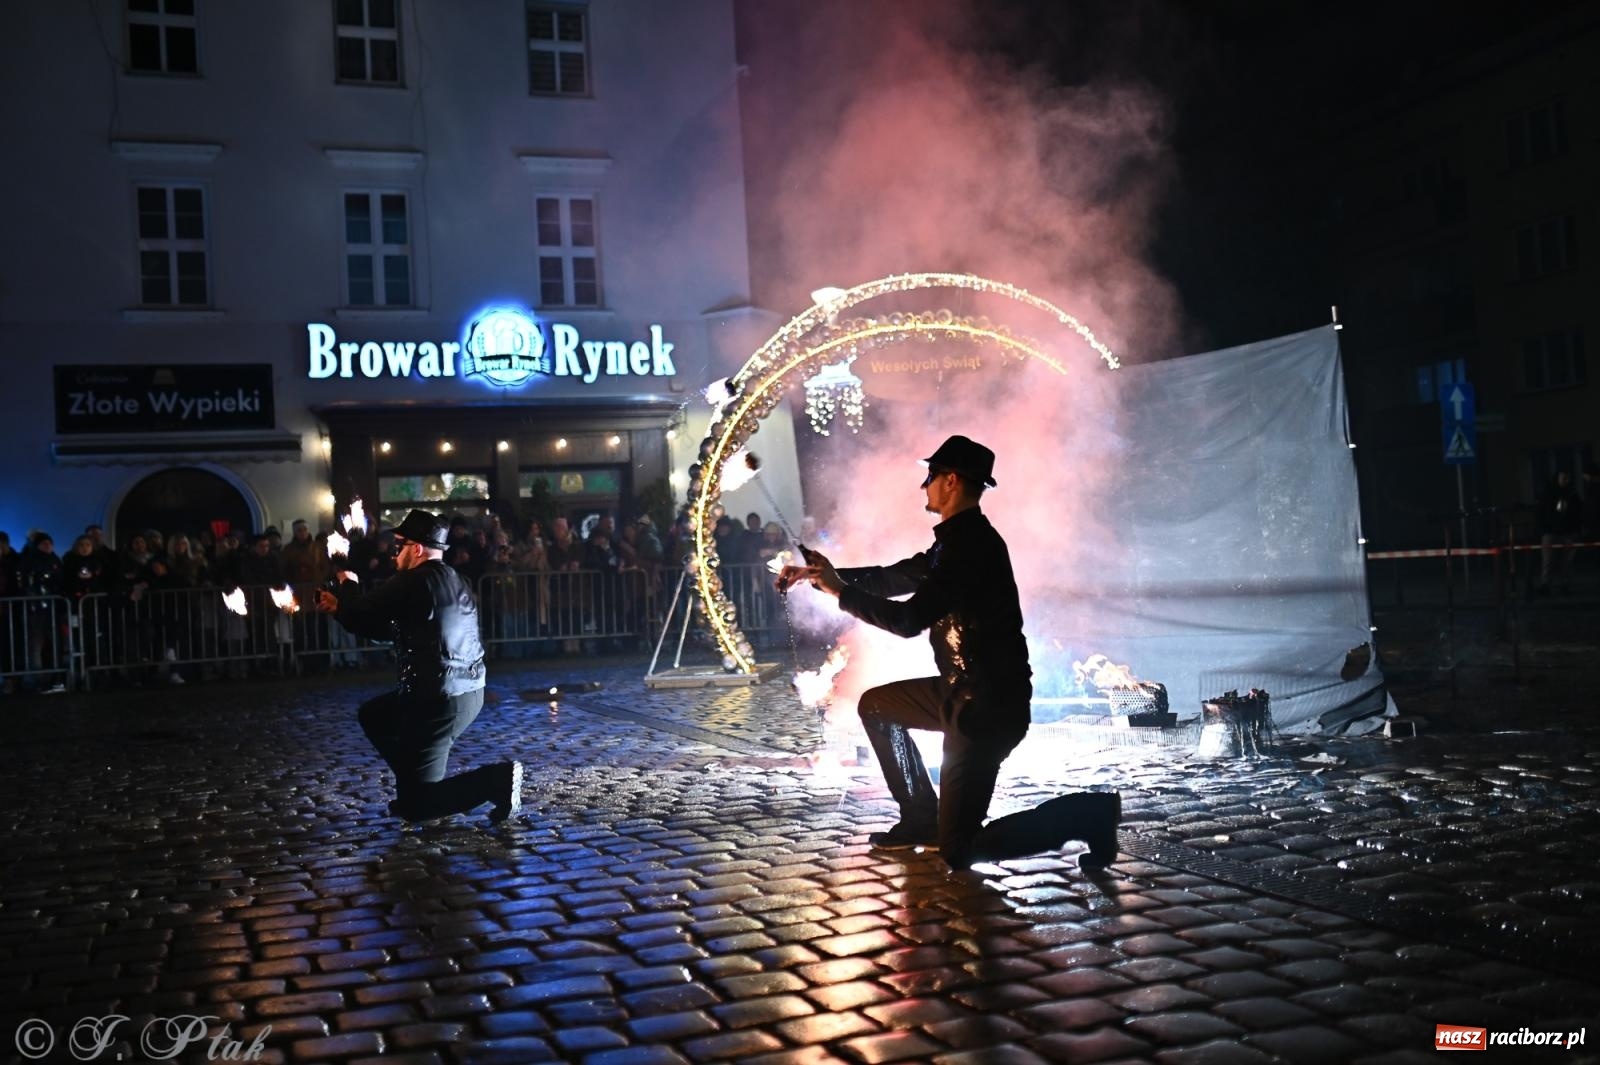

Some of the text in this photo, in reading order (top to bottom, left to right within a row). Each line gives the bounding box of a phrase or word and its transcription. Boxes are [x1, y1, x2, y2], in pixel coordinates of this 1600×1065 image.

[306, 323, 677, 385] Browar Rynek
[67, 387, 262, 421] Złote Wypieki
